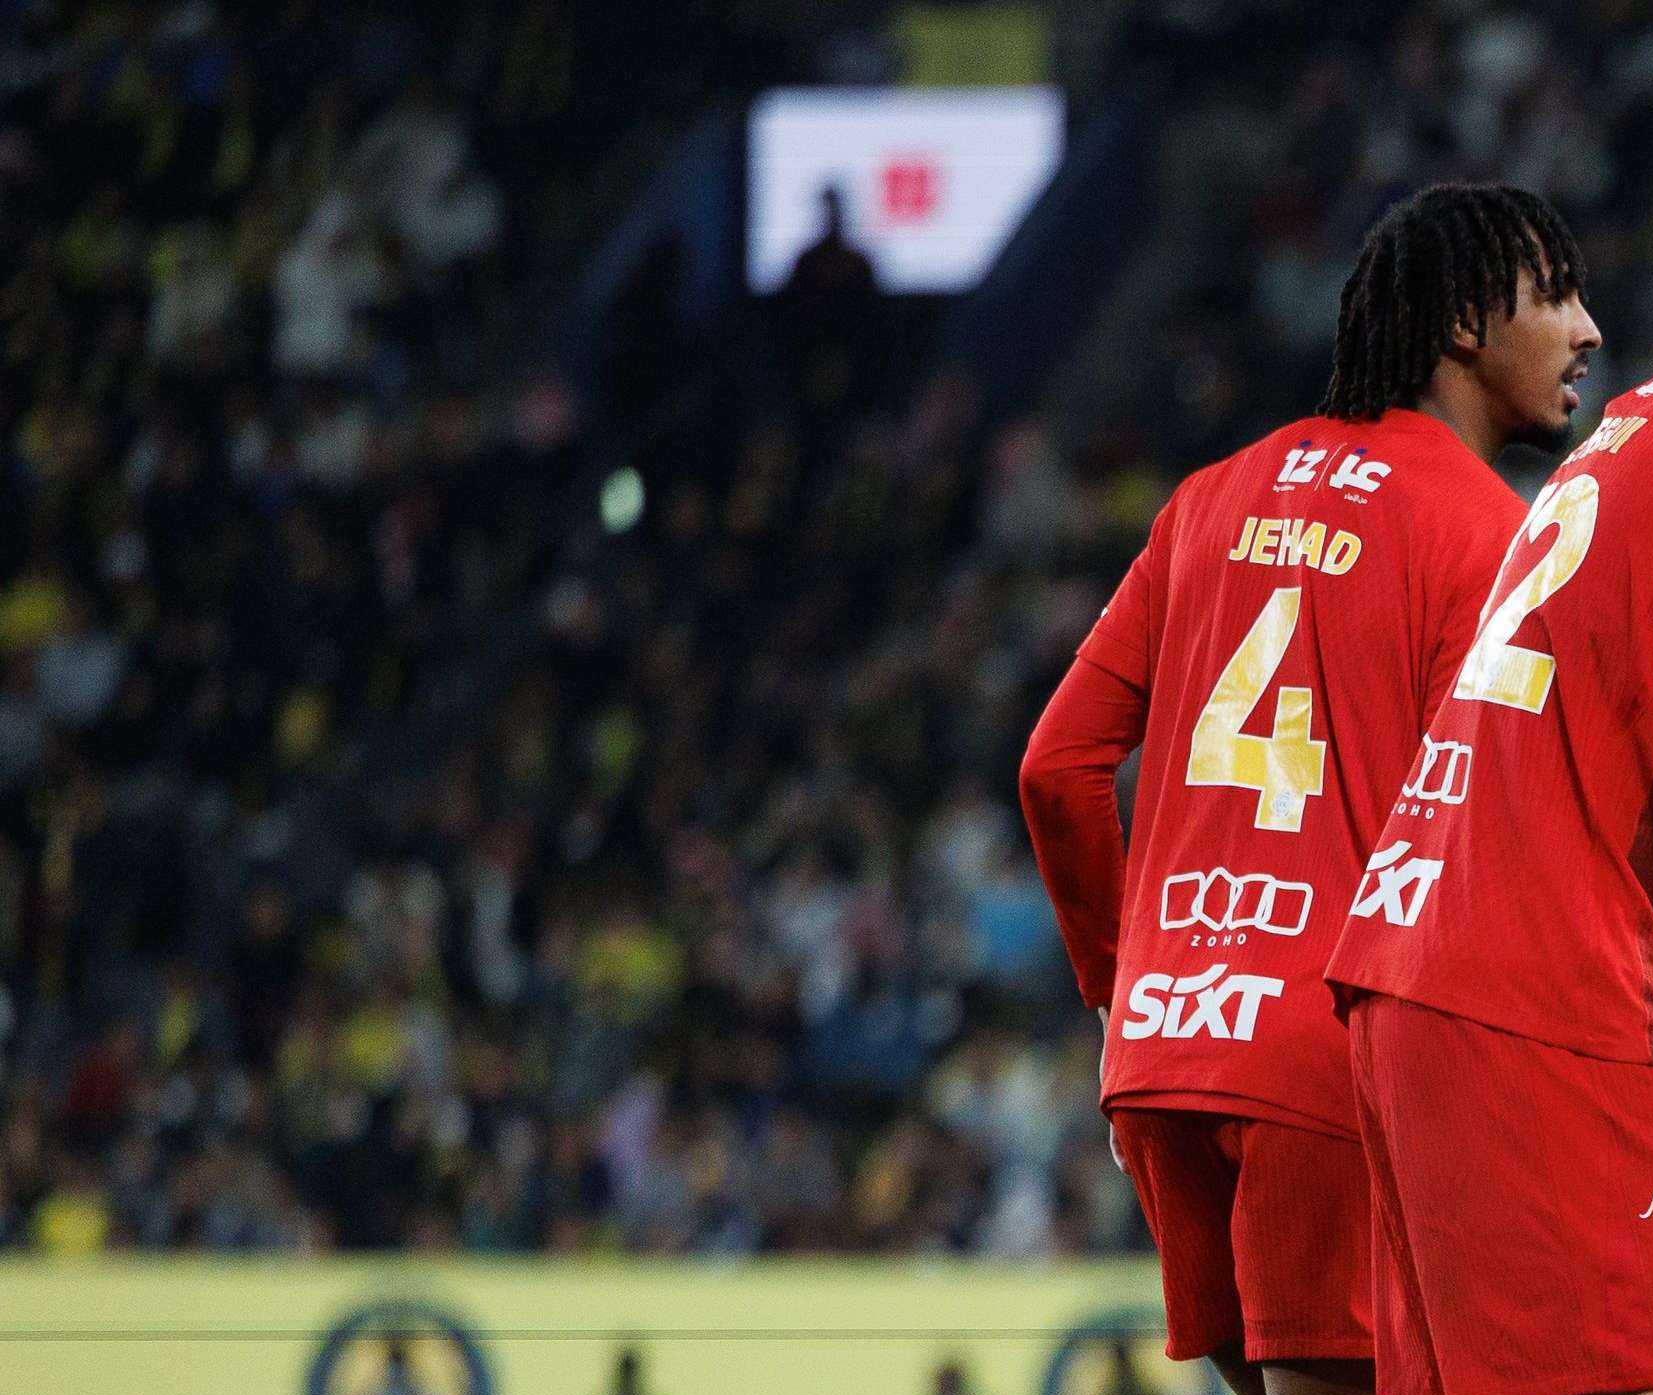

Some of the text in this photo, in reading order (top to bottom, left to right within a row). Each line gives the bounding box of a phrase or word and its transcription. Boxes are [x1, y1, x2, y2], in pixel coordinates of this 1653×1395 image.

[1229, 516, 1362, 575] JEHAD
[1452, 474, 1598, 715] 2
[1185, 586, 1327, 833] 4
[1349, 840, 1445, 927] IXT
[1190, 933, 1247, 947] ZOHO
